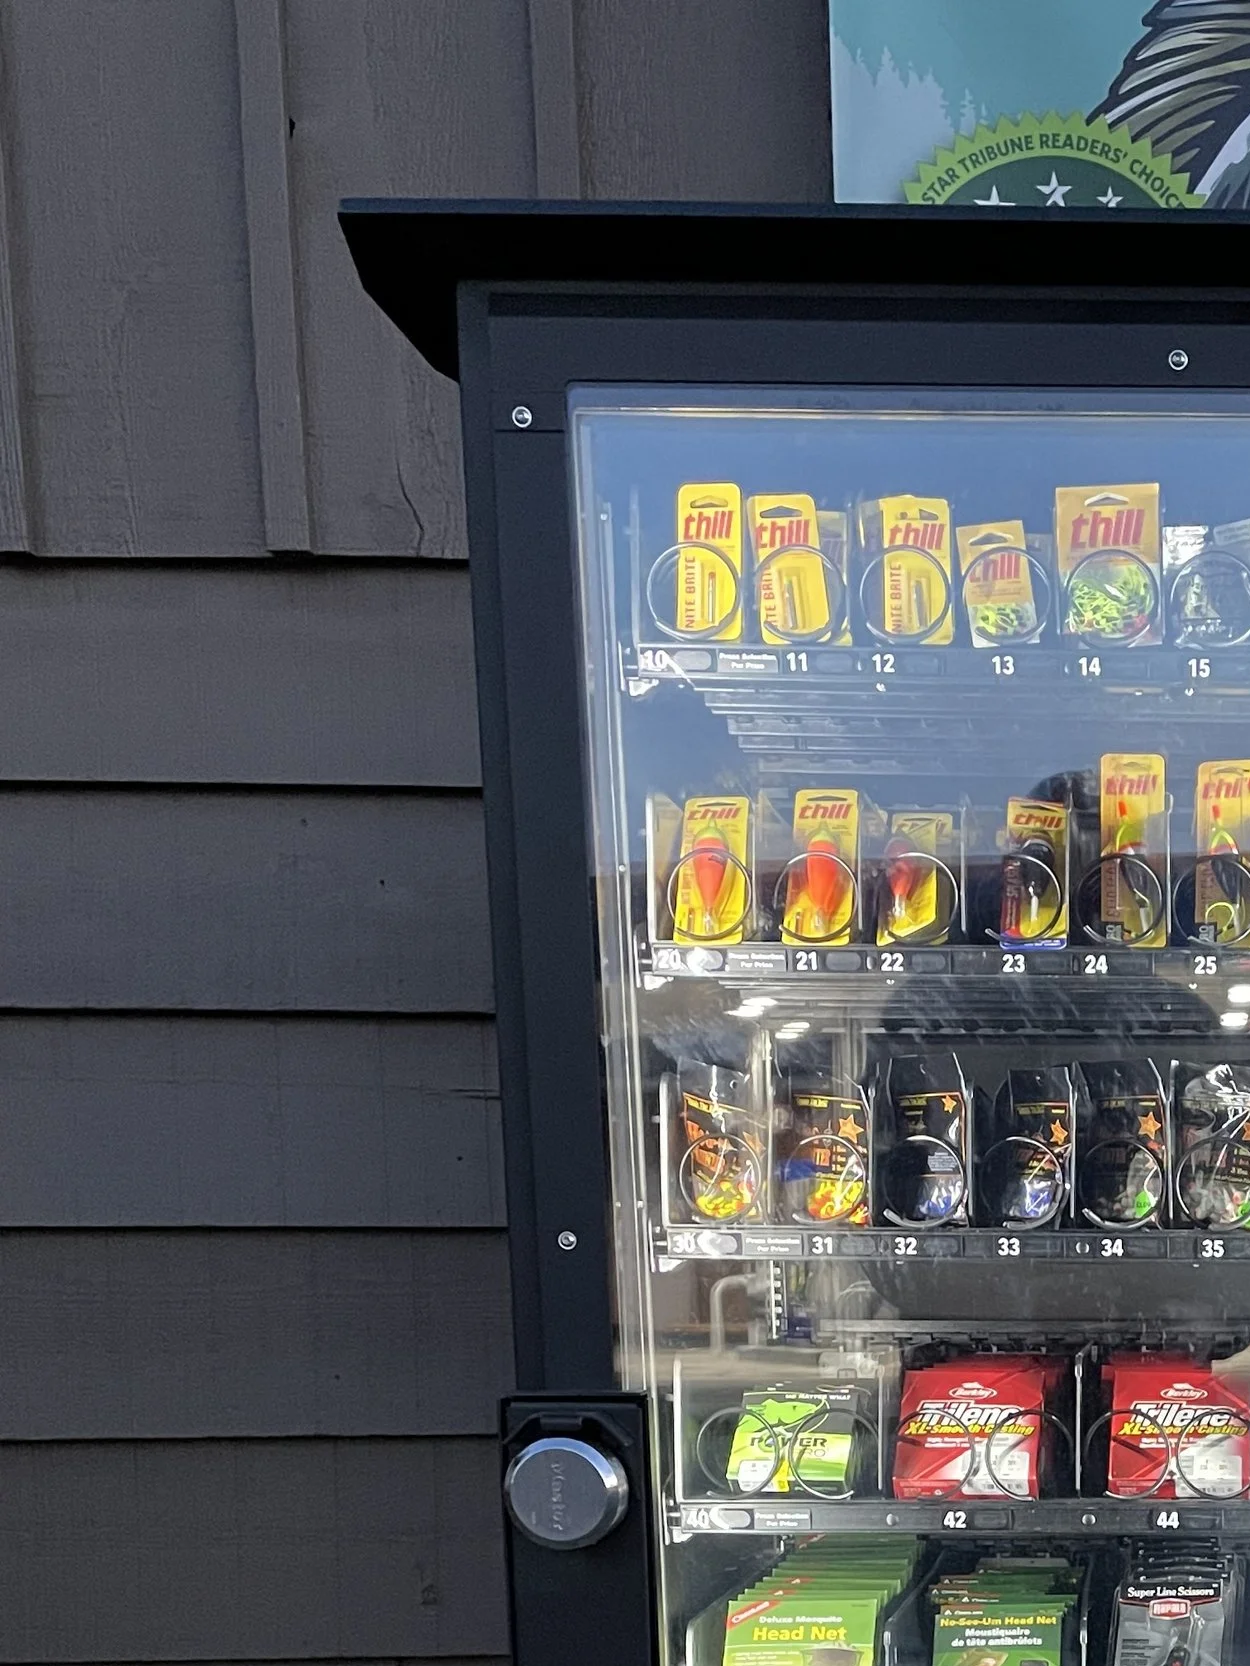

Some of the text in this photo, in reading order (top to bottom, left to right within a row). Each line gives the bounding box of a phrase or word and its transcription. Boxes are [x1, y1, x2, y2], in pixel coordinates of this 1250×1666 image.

[921, 132, 1188, 208] STAR TRIBUNE READERS' CHOIC
[683, 510, 734, 541] thill
[755, 519, 811, 549] thill
[1071, 508, 1145, 549] thill
[888, 523, 945, 551] thill
[685, 555, 697, 628] NITE BRITE
[787, 653, 808, 671] 11
[871, 654, 895, 673] 12
[991, 656, 1015, 675] 13
[1078, 657, 1101, 676] 14
[1188, 658, 1211, 677] 15
[687, 806, 741, 821] thill
[798, 803, 851, 820] thill
[795, 951, 818, 971] 21
[881, 952, 904, 972] 22
[1002, 954, 1025, 973] 23
[1084, 955, 1108, 975] 24
[1194, 956, 1217, 975] 25
[811, 1236, 833, 1254] 31
[894, 1237, 917, 1255] 32
[998, 1238, 1020, 1256] 33
[1101, 1239, 1124, 1256] 34
[1201, 1239, 1224, 1257] 35
[1133, 1402, 1231, 1426] Trilene
[983, 1423, 1035, 1436] Csting
[943, 1511, 967, 1529] 42
[1156, 1511, 1180, 1529] 44
[1127, 1586, 1215, 1600] Super Line Scissors
[795, 1616, 843, 1624] Mosquito
[1005, 1616, 1033, 1626] Head
[1036, 1615, 1057, 1625] Net
[753, 1625, 847, 1641] Head Net
[951, 1638, 964, 1647] de
